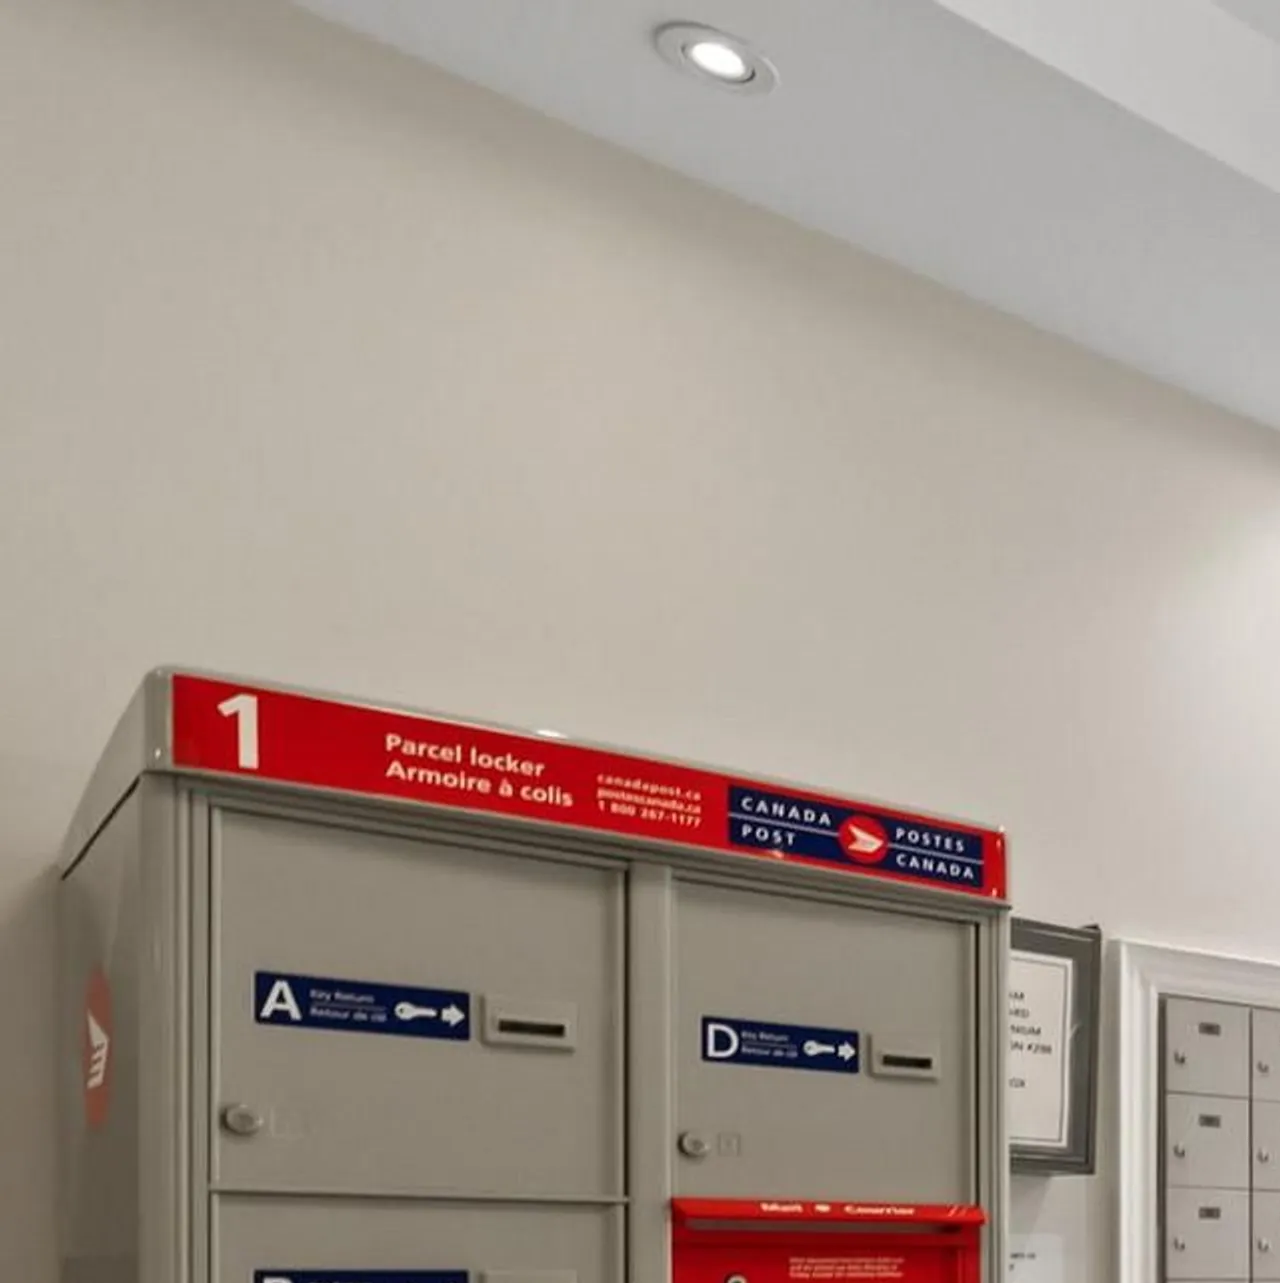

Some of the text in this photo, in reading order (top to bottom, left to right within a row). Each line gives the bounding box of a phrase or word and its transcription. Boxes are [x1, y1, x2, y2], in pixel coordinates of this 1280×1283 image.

[217, 693, 259, 769] 1
[385, 732, 545, 776] Parcel locker
[386, 760, 574, 807] Armoire à colis
[597, 774, 701, 801] canadapost.ca
[741, 797, 831, 826] CANADA
[741, 825, 797, 846] POST
[896, 827, 965, 853] POSTES
[896, 854, 974, 879] CANADA
[259, 979, 302, 1021] A
[707, 1023, 739, 1058] D
